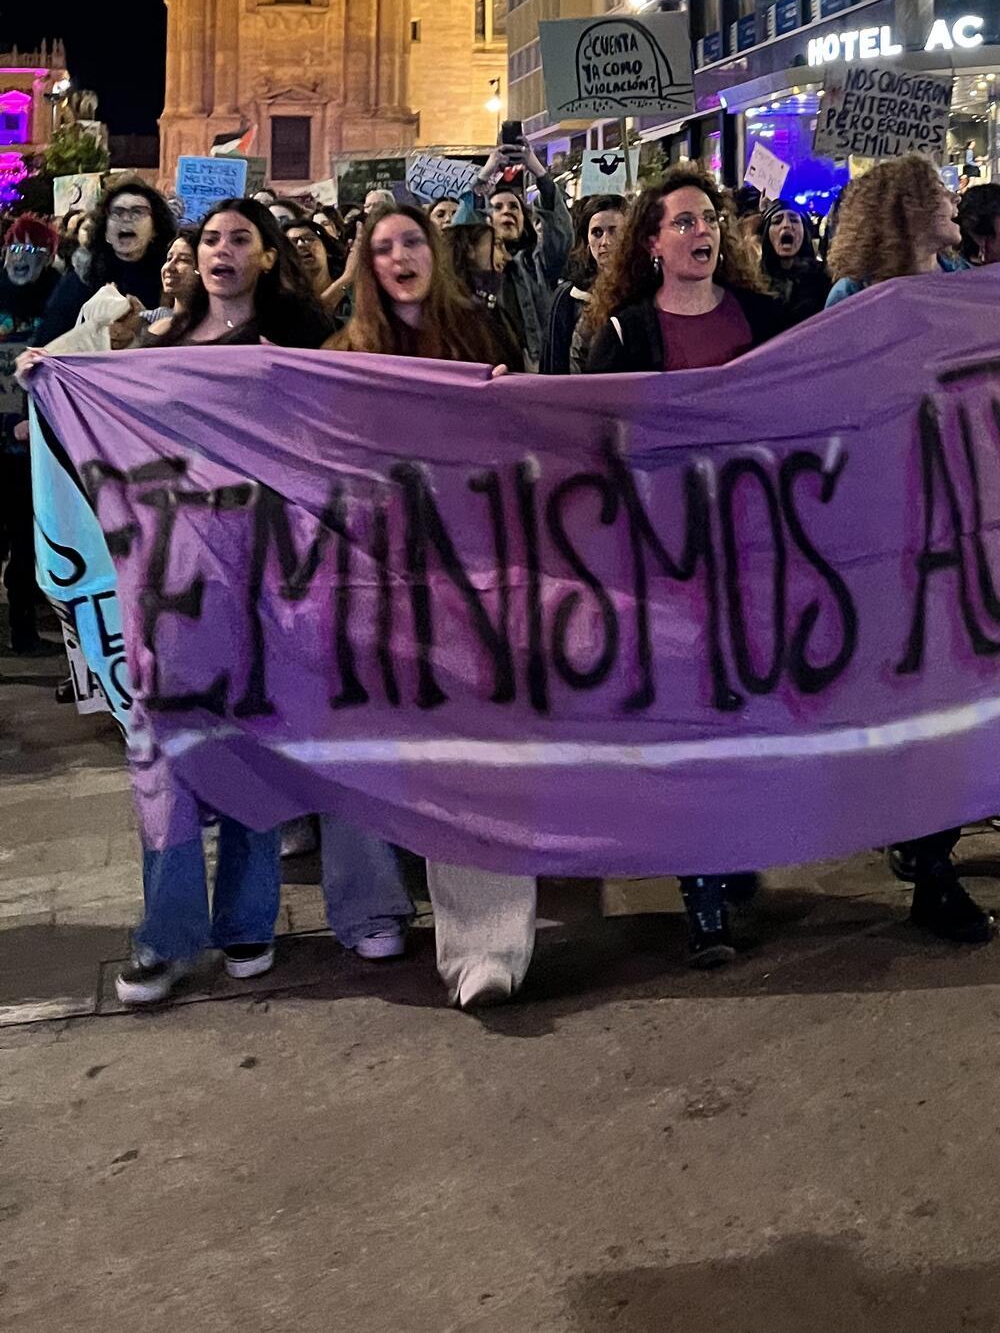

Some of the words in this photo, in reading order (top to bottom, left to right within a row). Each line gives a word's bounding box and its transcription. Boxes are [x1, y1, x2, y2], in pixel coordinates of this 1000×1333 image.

[583, 33, 639, 61] ¿CUENTA
[807, 25, 903, 67] HOTEL
[924, 15, 984, 52] AC
[603, 60, 643, 77] COMO
[584, 75, 657, 96] VIOLACIÓN?
[844, 68, 878, 92] NOS
[878, 71, 953, 106] QUISIERON
[826, 108, 874, 131] PERO
[842, 93, 931, 123] ENTERRAR
[80, 421, 860, 716] FEMINISMOS
